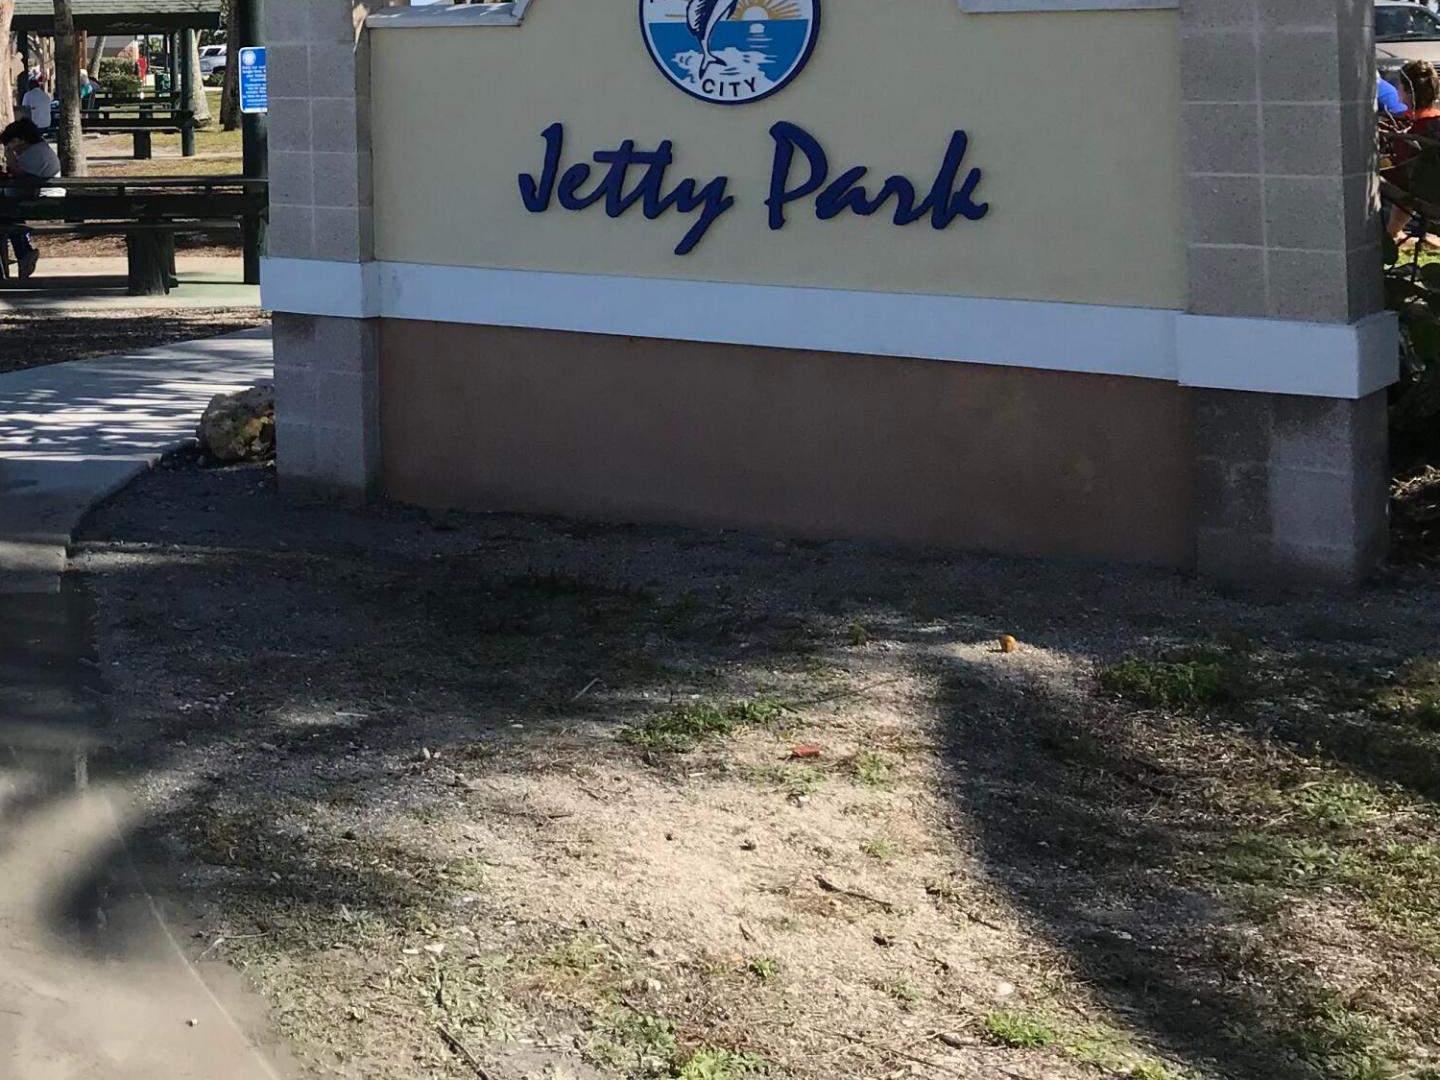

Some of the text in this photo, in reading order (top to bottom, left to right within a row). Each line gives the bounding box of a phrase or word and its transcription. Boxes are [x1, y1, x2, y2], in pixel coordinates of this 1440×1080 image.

[701, 77, 757, 97] CITY
[518, 120, 989, 256] Jetty Park
